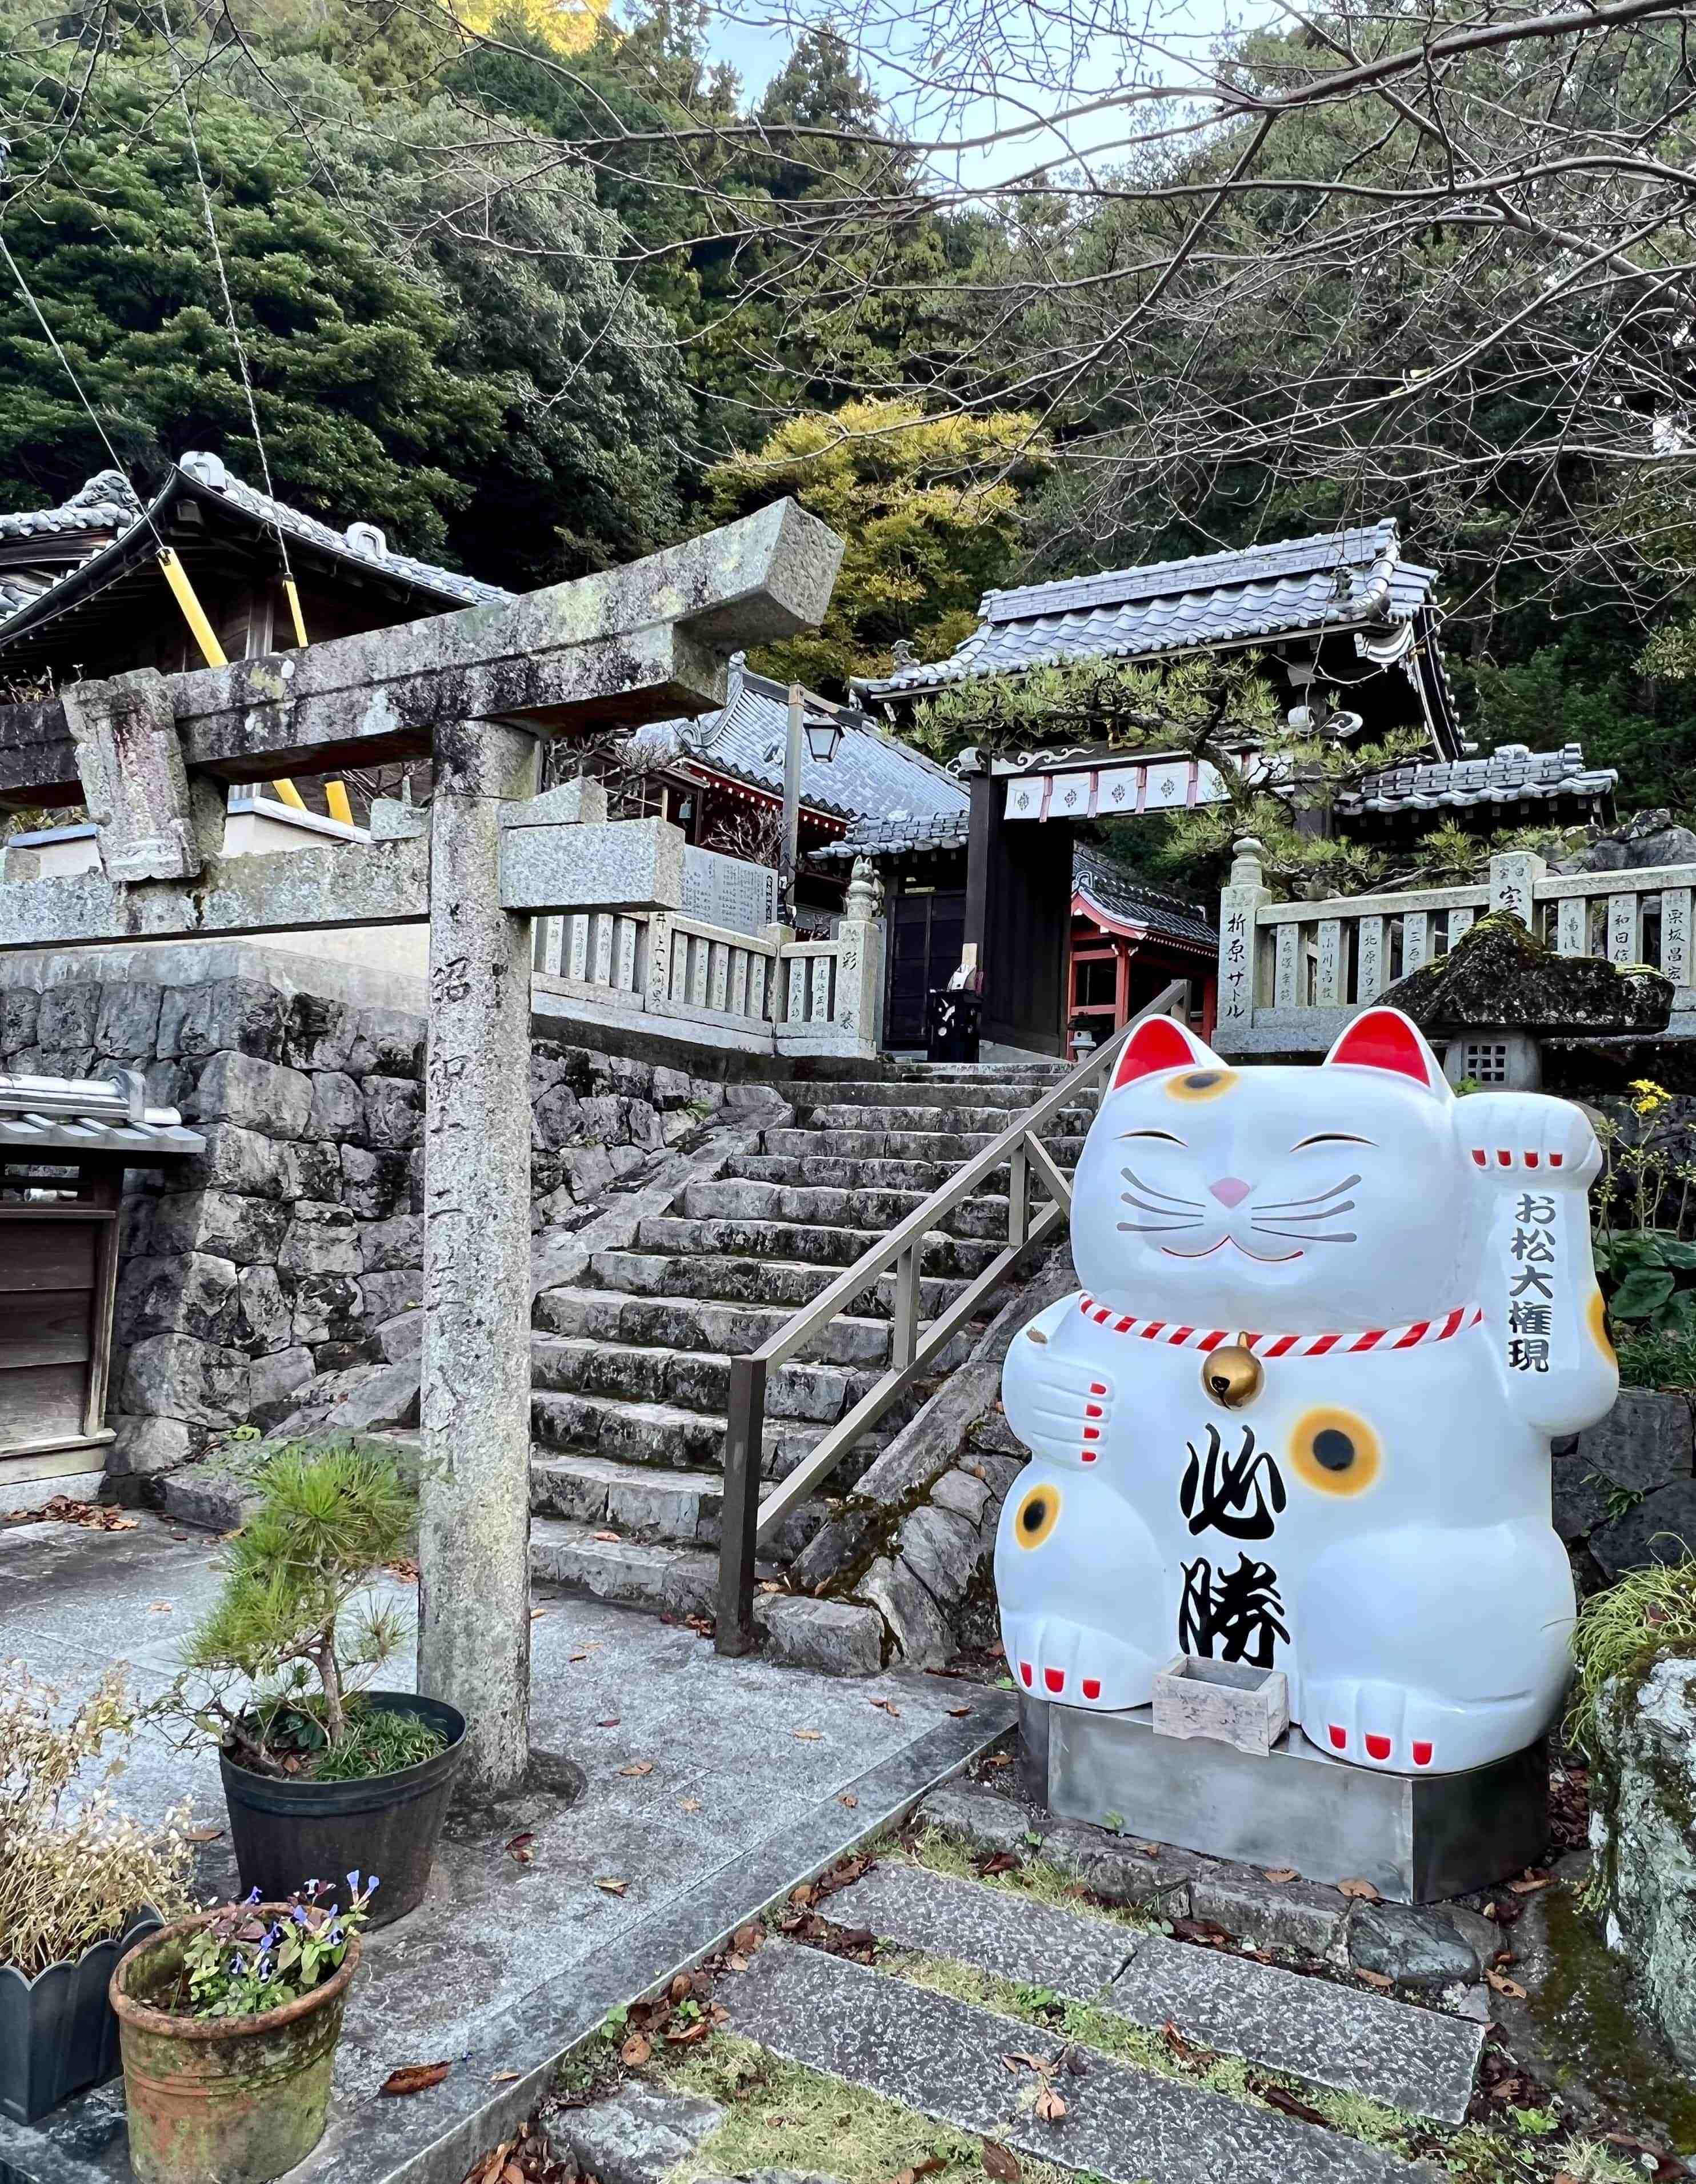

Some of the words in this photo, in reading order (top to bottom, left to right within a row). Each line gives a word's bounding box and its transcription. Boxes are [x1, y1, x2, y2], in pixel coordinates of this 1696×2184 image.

[1508, 1193, 1557, 1373] お松大権現
[1179, 1422, 1290, 1670] 必勝
